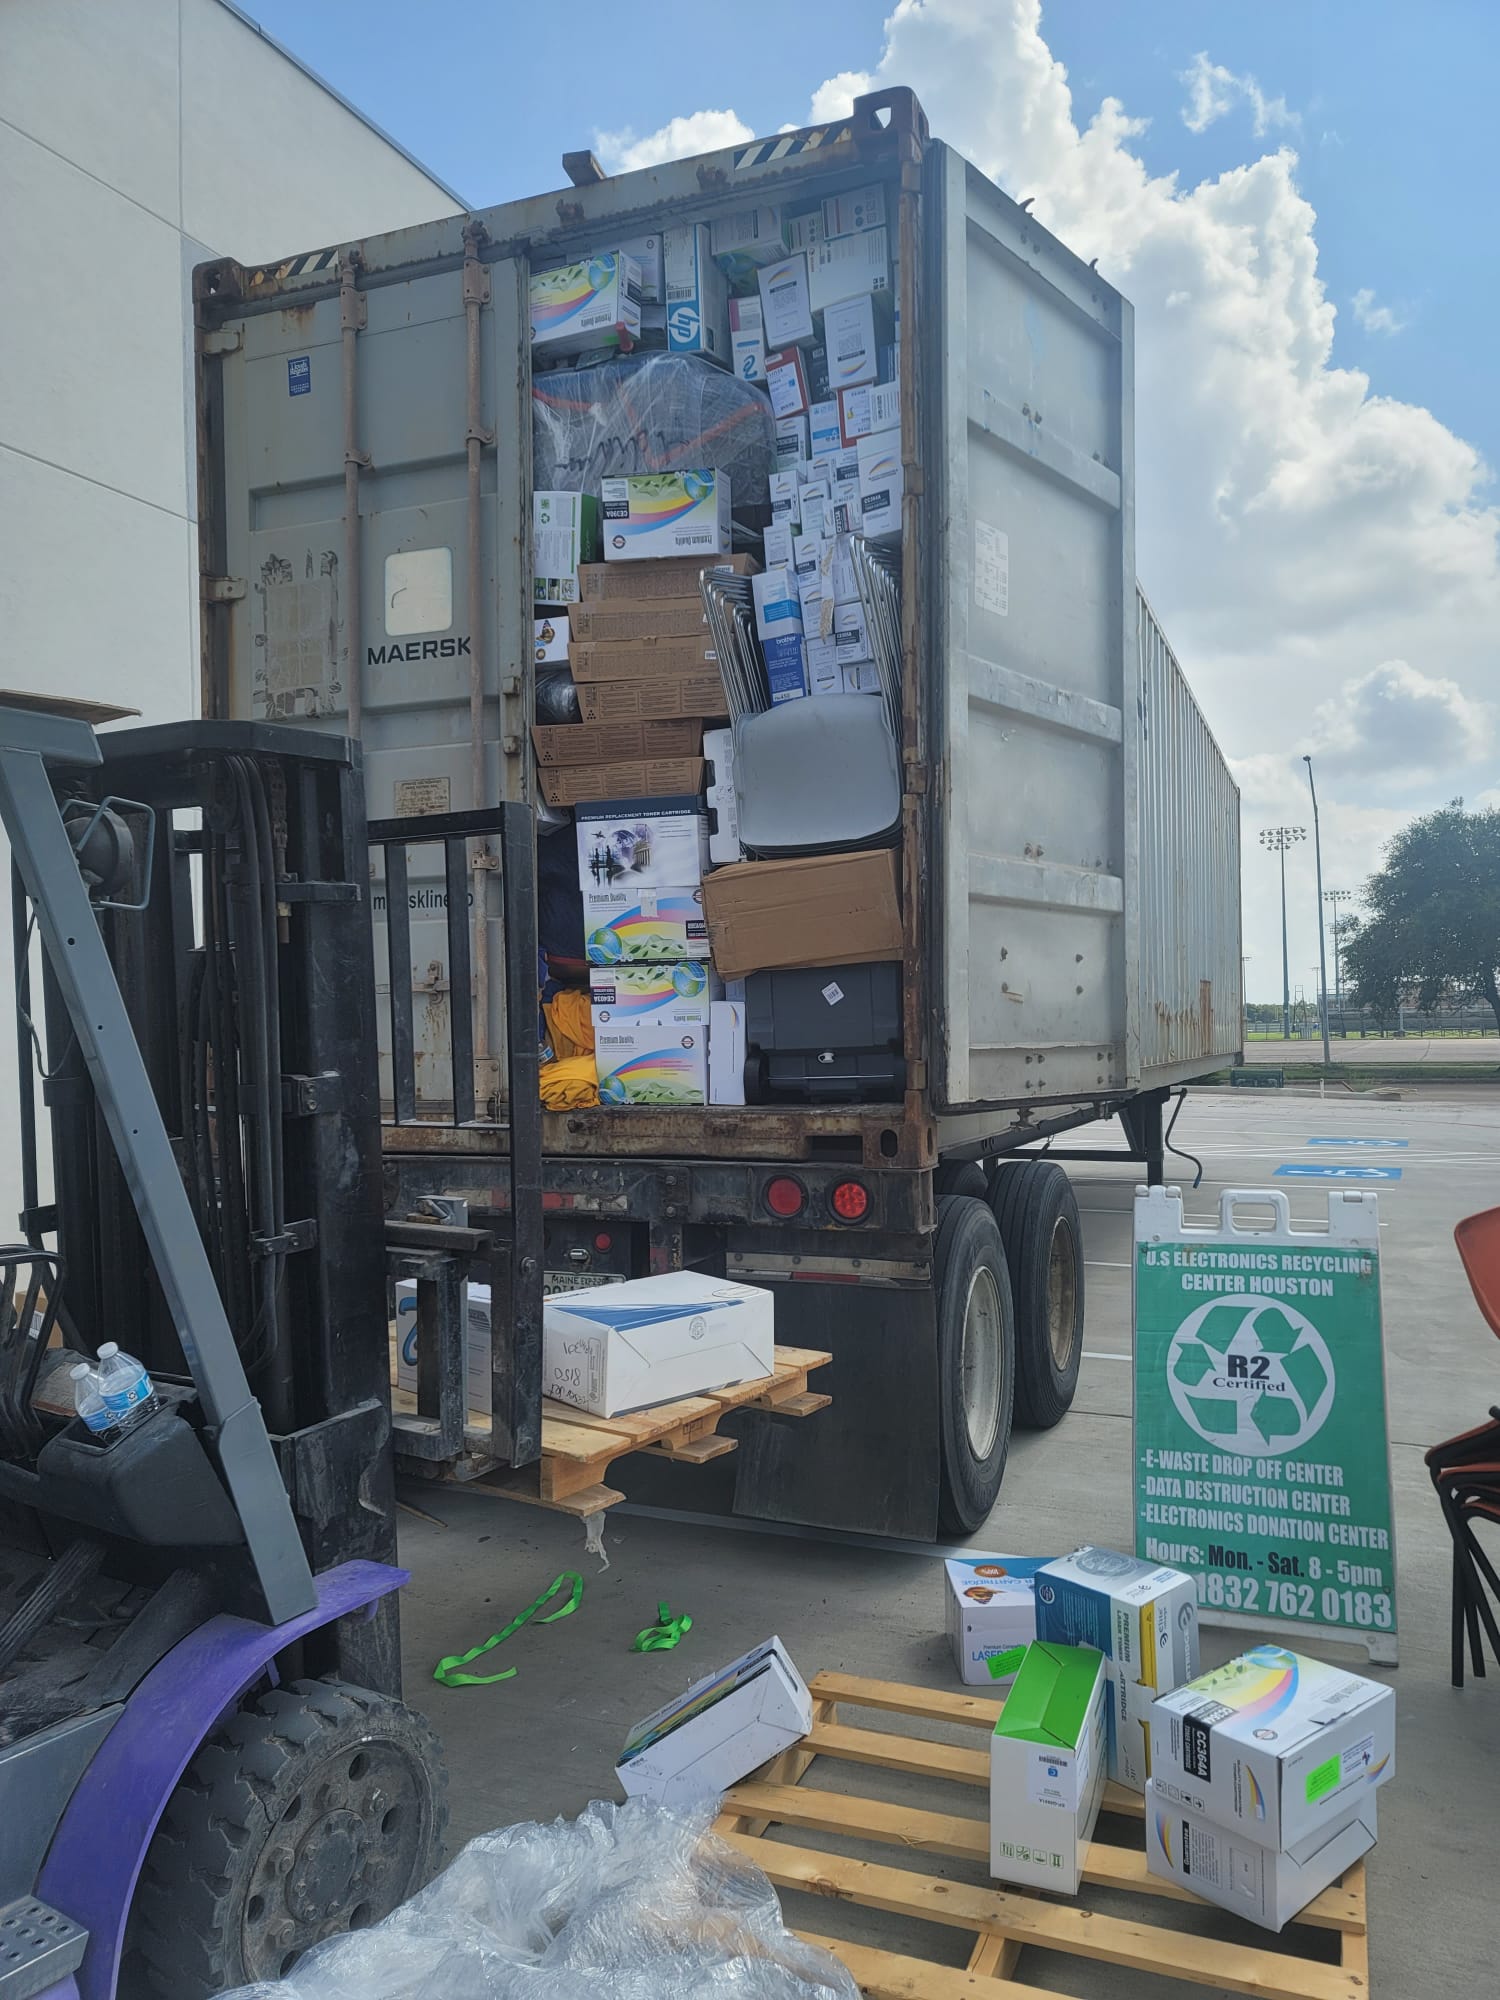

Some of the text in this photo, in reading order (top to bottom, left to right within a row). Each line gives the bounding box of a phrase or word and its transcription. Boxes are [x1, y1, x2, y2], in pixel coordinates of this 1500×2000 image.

[675, 535, 713, 546] Premium Quality
[367, 636, 471, 665] MAERSK
[776, 635, 797, 647] brother
[605, 811, 642, 820] REPLACEMENT
[588, 893, 610, 904] Premium
[599, 1035, 635, 1045] Premium Quality
[1146, 1251, 1372, 1274] U.S ELECTRONICS RECYCLING
[551, 1275, 580, 1285] MAINE
[1181, 1274, 1334, 1297] CENTER HOUSTON
[1227, 1354, 1271, 1381] R2
[1212, 1377, 1286, 1393] Certified
[1212, 1455, 1252, 1477] DROP
[1256, 1458, 1282, 1480] OFF
[1285, 1460, 1344, 1487] CENTER
[1140, 1476, 1351, 1517] -DATA DESTRUCTION CENTER
[1140, 1503, 1389, 1550] -ELECTRONICS DONATION CENTER
[1145, 1537, 1205, 1565] Hours:
[1208, 1545, 1253, 1571] Mon.
[1267, 1551, 1305, 1578] Sat.
[1308, 1556, 1322, 1579] 8
[1337, 1560, 1383, 1587] 5pm
[1197, 1572, 1392, 1628] 1832 762 0183
[1123, 1612, 1131, 1663] PREMIUM
[1196, 1730, 1208, 1776] CC364A
